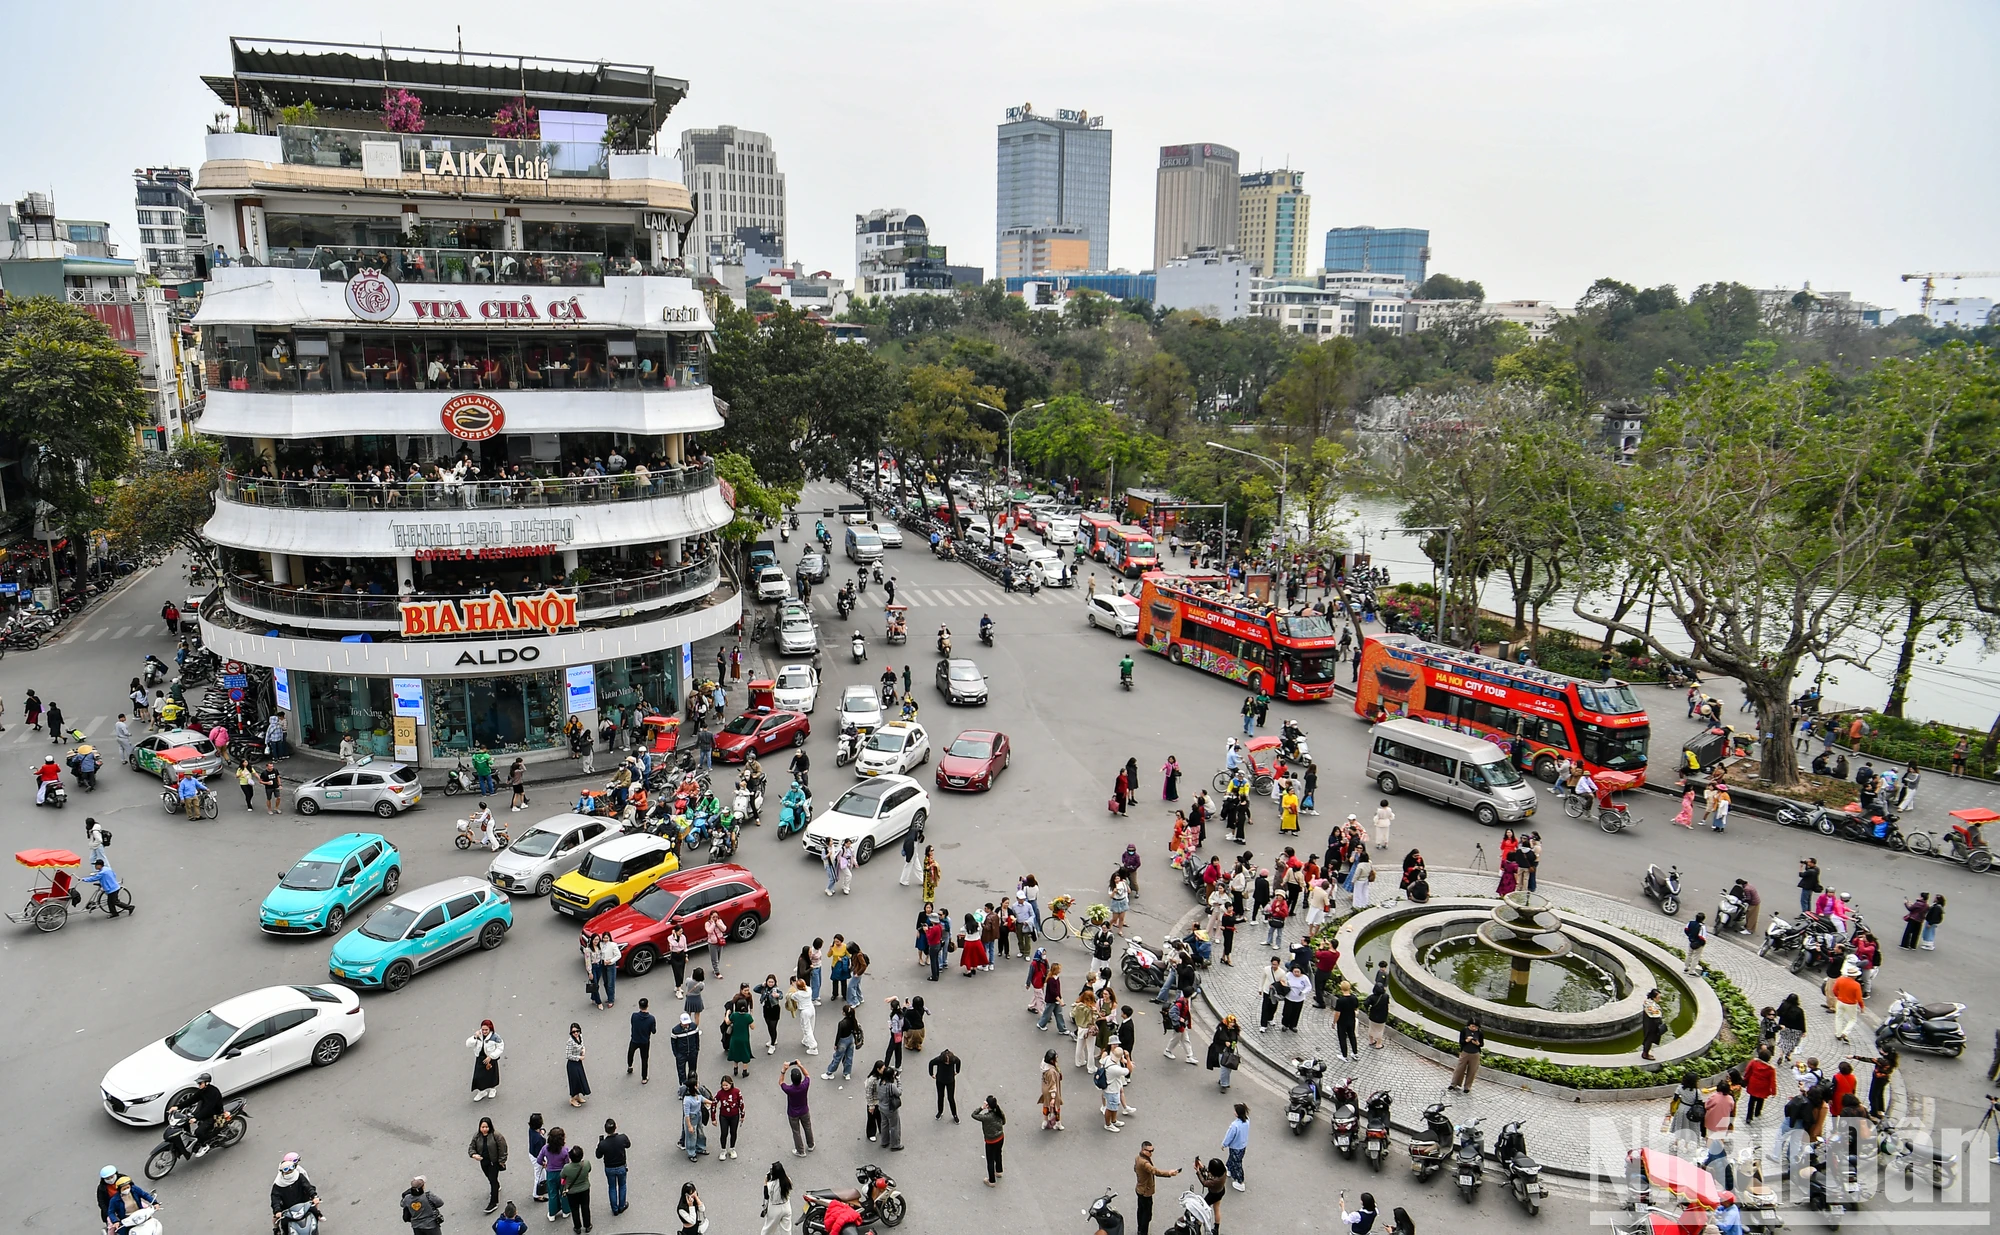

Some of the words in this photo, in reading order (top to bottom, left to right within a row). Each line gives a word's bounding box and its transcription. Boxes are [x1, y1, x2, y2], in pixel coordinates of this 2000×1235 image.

[1060, 109, 1080, 121] BIDV
[419, 150, 511, 178] LAIKA
[514, 154, 549, 180] Café
[1161, 157, 1189, 168] GROUP
[643, 211, 678, 232] LAIKA
[409, 300, 471, 319] VUA
[479, 294, 540, 320] CHẢ
[547, 295, 587, 320] CÁ
[444, 397, 501, 416] HIGHLANDS
[453, 426, 496, 439] COFFEE
[393, 523, 451, 547] HANOI
[458, 521, 503, 545] 1930
[511, 518, 575, 543] BISTRO
[415, 548, 461, 561] COFFEE
[465, 548, 474, 560] &
[479, 544, 557, 560] RESTAURANT
[401, 602, 461, 635] BIA
[463, 592, 513, 631] HÀ
[514, 591, 577, 634] NỘI
[1207, 613, 1220, 623] CITY
[1220, 617, 1236, 628] TOUR
[455, 646, 540, 666] ALDO
[1436, 673, 1447, 682] HA
[1449, 676, 1463, 687] NOI
[1465, 681, 1483, 692] CITY
[1485, 686, 1507, 698] TOUR
[397, 728, 409, 738] 30
